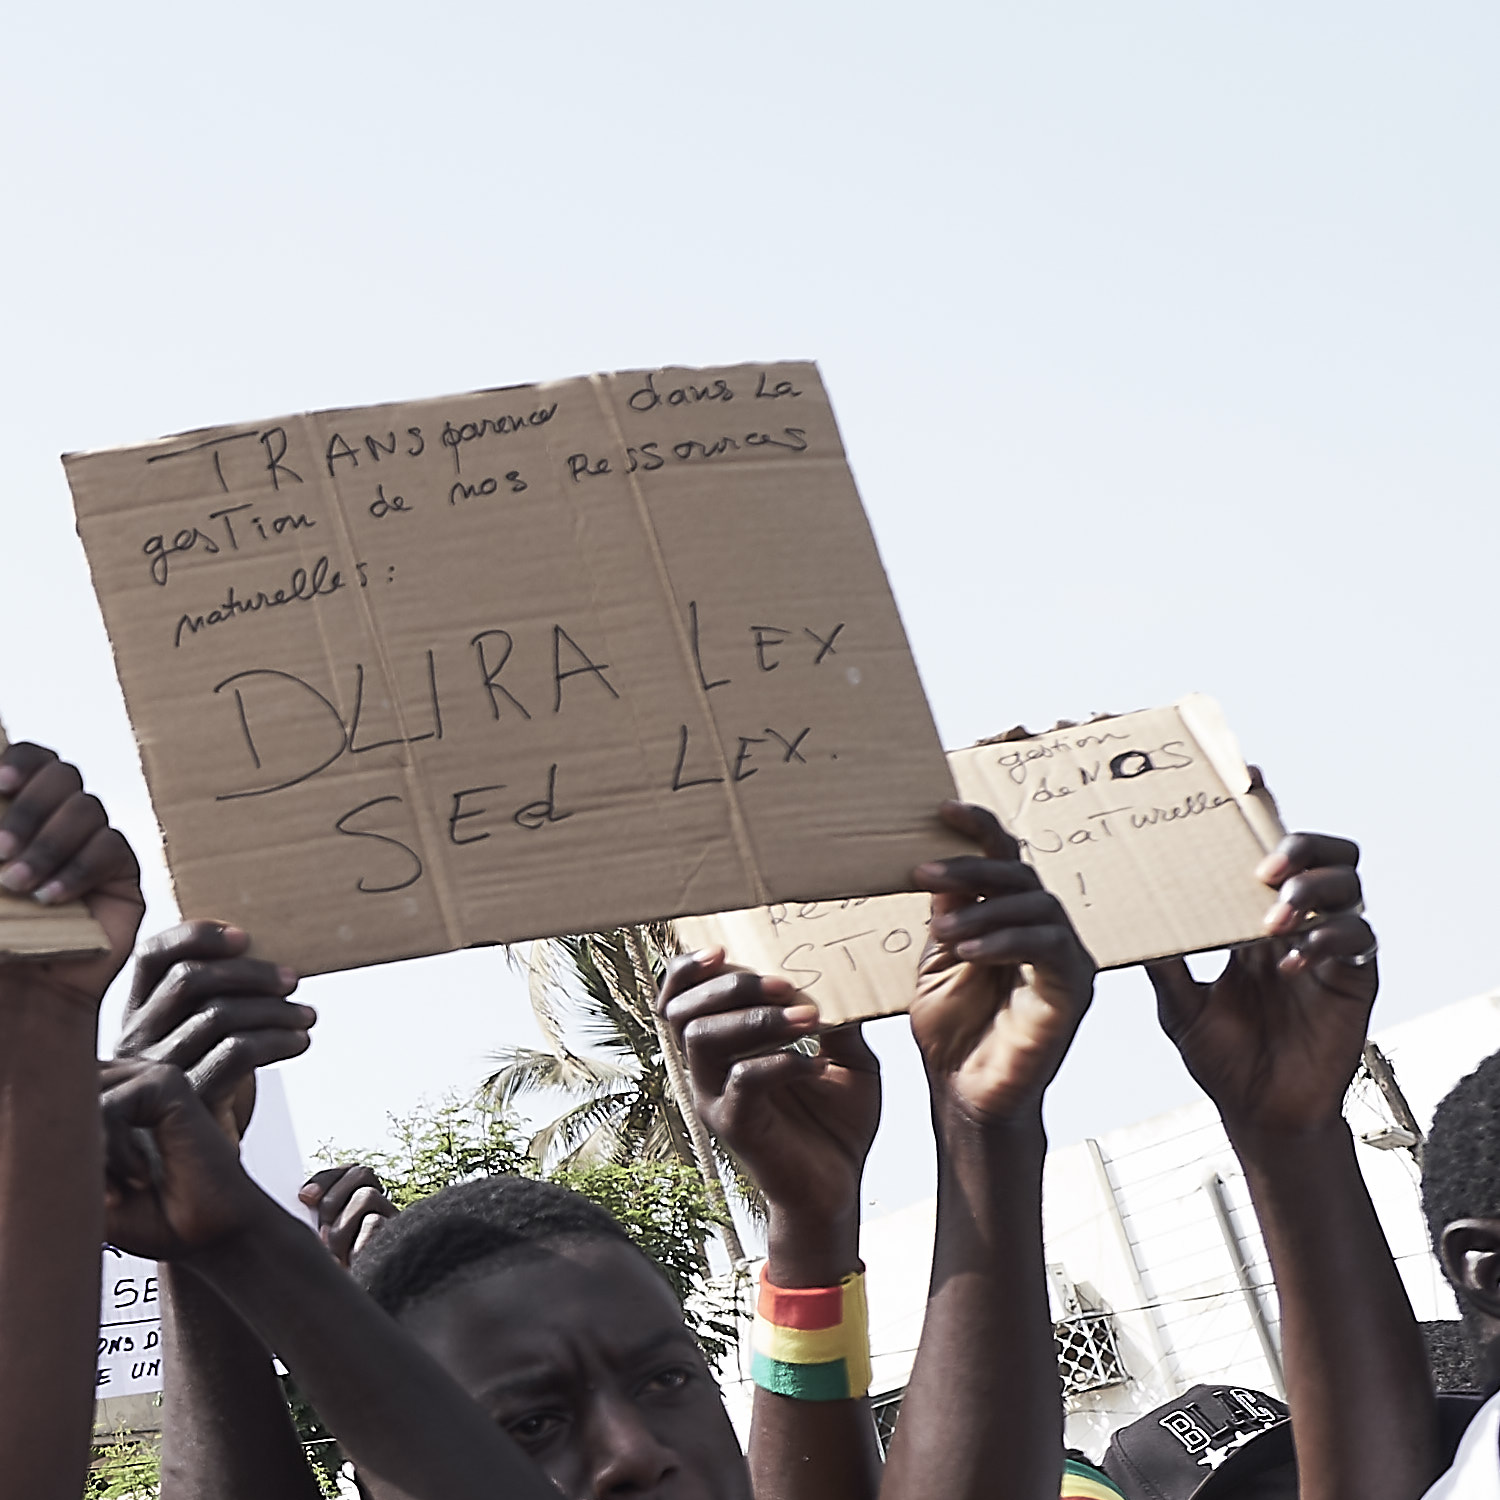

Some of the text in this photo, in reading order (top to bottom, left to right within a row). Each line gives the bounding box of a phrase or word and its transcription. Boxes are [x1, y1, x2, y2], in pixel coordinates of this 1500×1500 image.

[628, 373, 736, 413] dans
[369, 484, 414, 519] de
[449, 469, 529, 506] nos
[213, 600, 846, 801] DURA LEX
